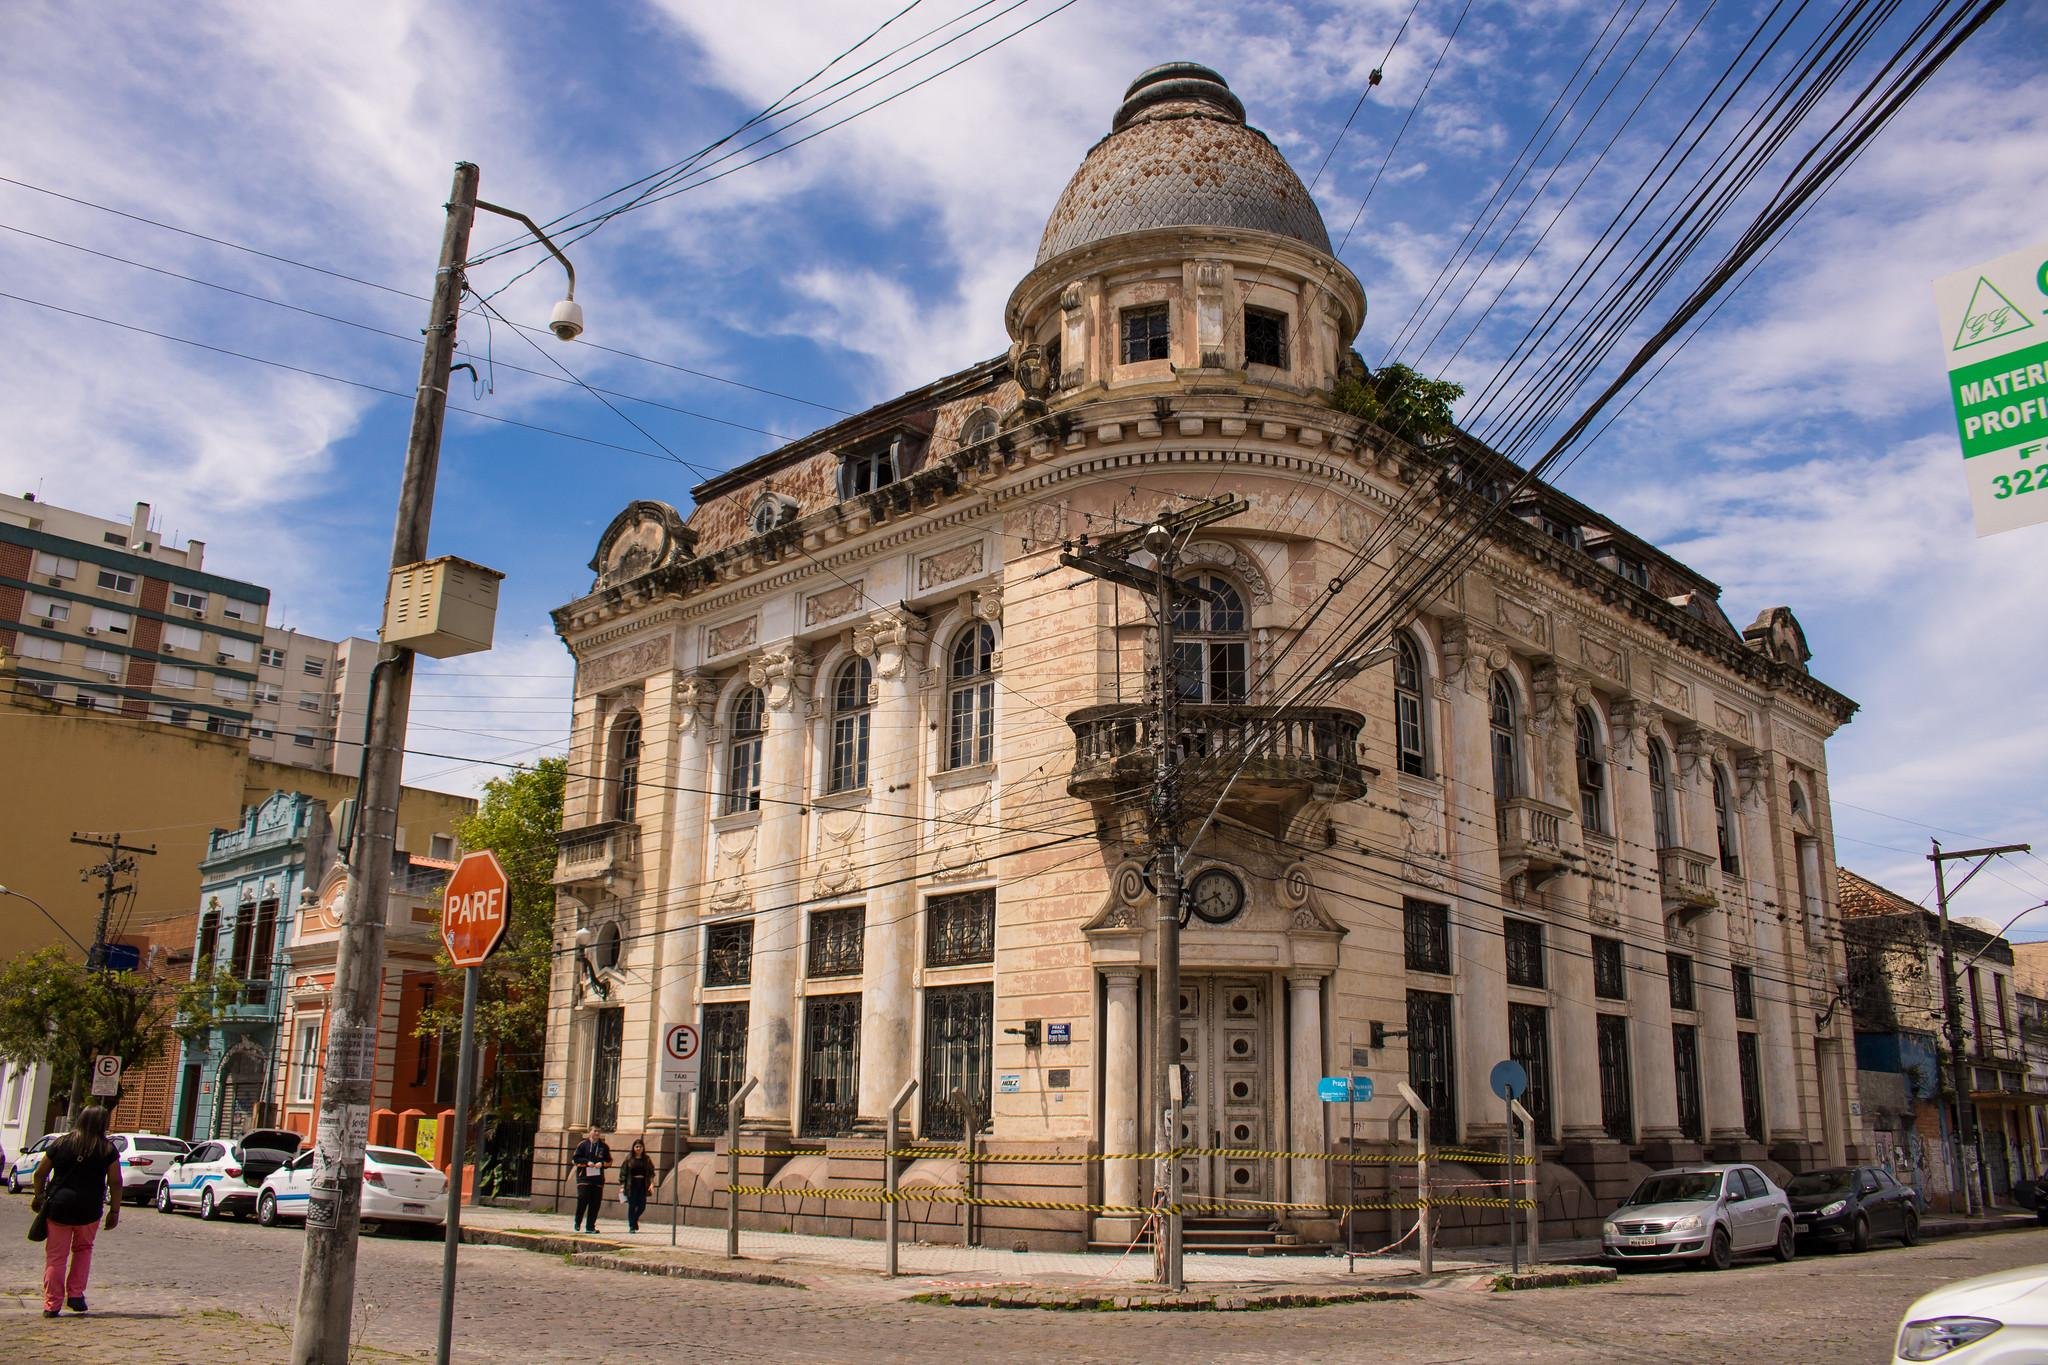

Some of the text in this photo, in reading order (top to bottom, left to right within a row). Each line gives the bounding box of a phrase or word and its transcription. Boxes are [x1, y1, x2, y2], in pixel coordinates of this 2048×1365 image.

[1965, 397, 2048, 441] PROFI
[447, 888, 501, 927] PARE
[676, 1032, 688, 1052] E
[104, 1061, 112, 1072] E
